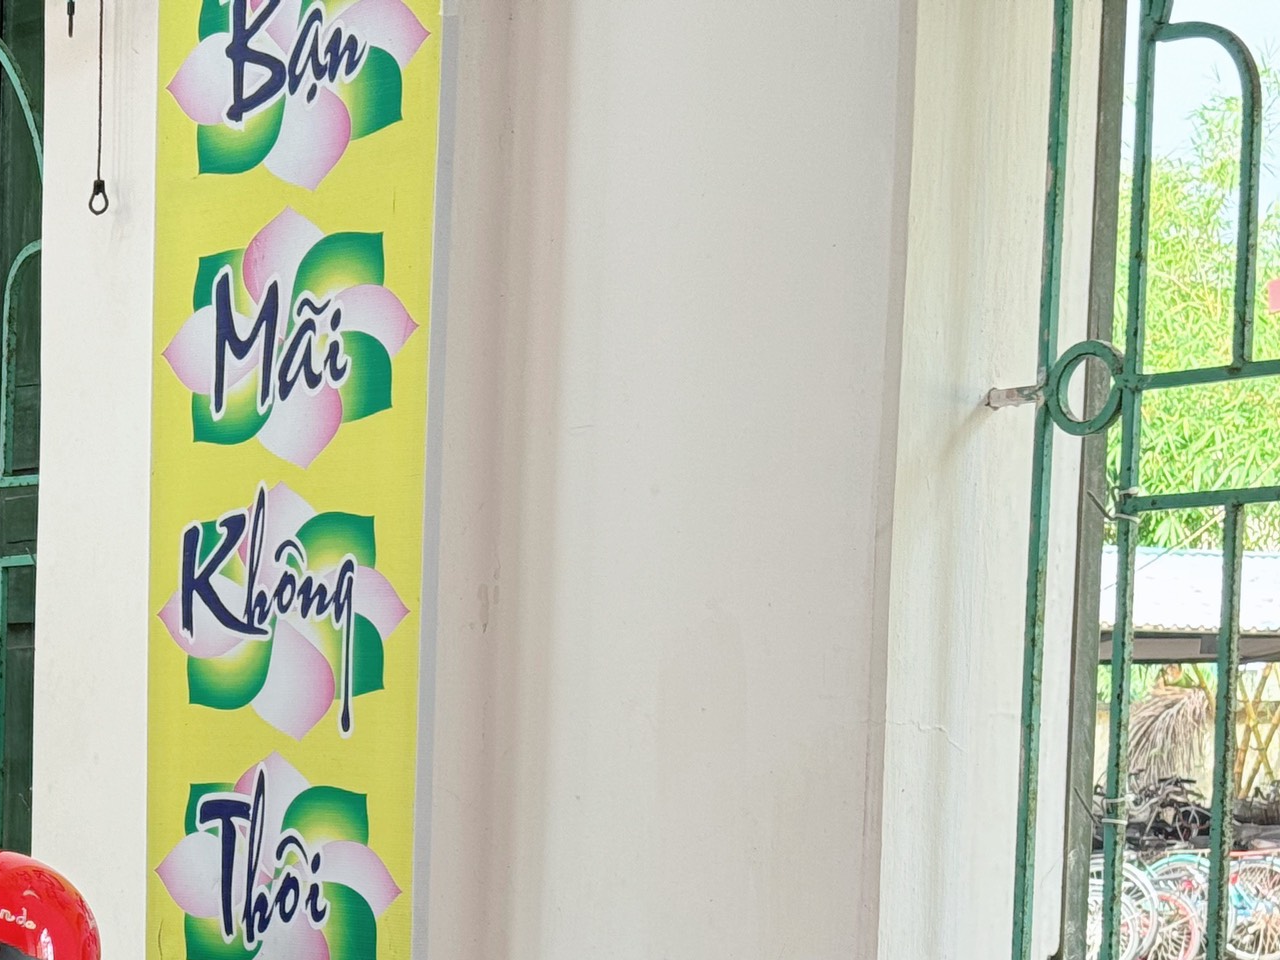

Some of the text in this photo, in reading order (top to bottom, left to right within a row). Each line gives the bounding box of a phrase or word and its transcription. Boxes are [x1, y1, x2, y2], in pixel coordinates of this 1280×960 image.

[214, 271, 348, 414] Mãi
[181, 486, 355, 733] Không
[200, 769, 327, 940] Thôi
